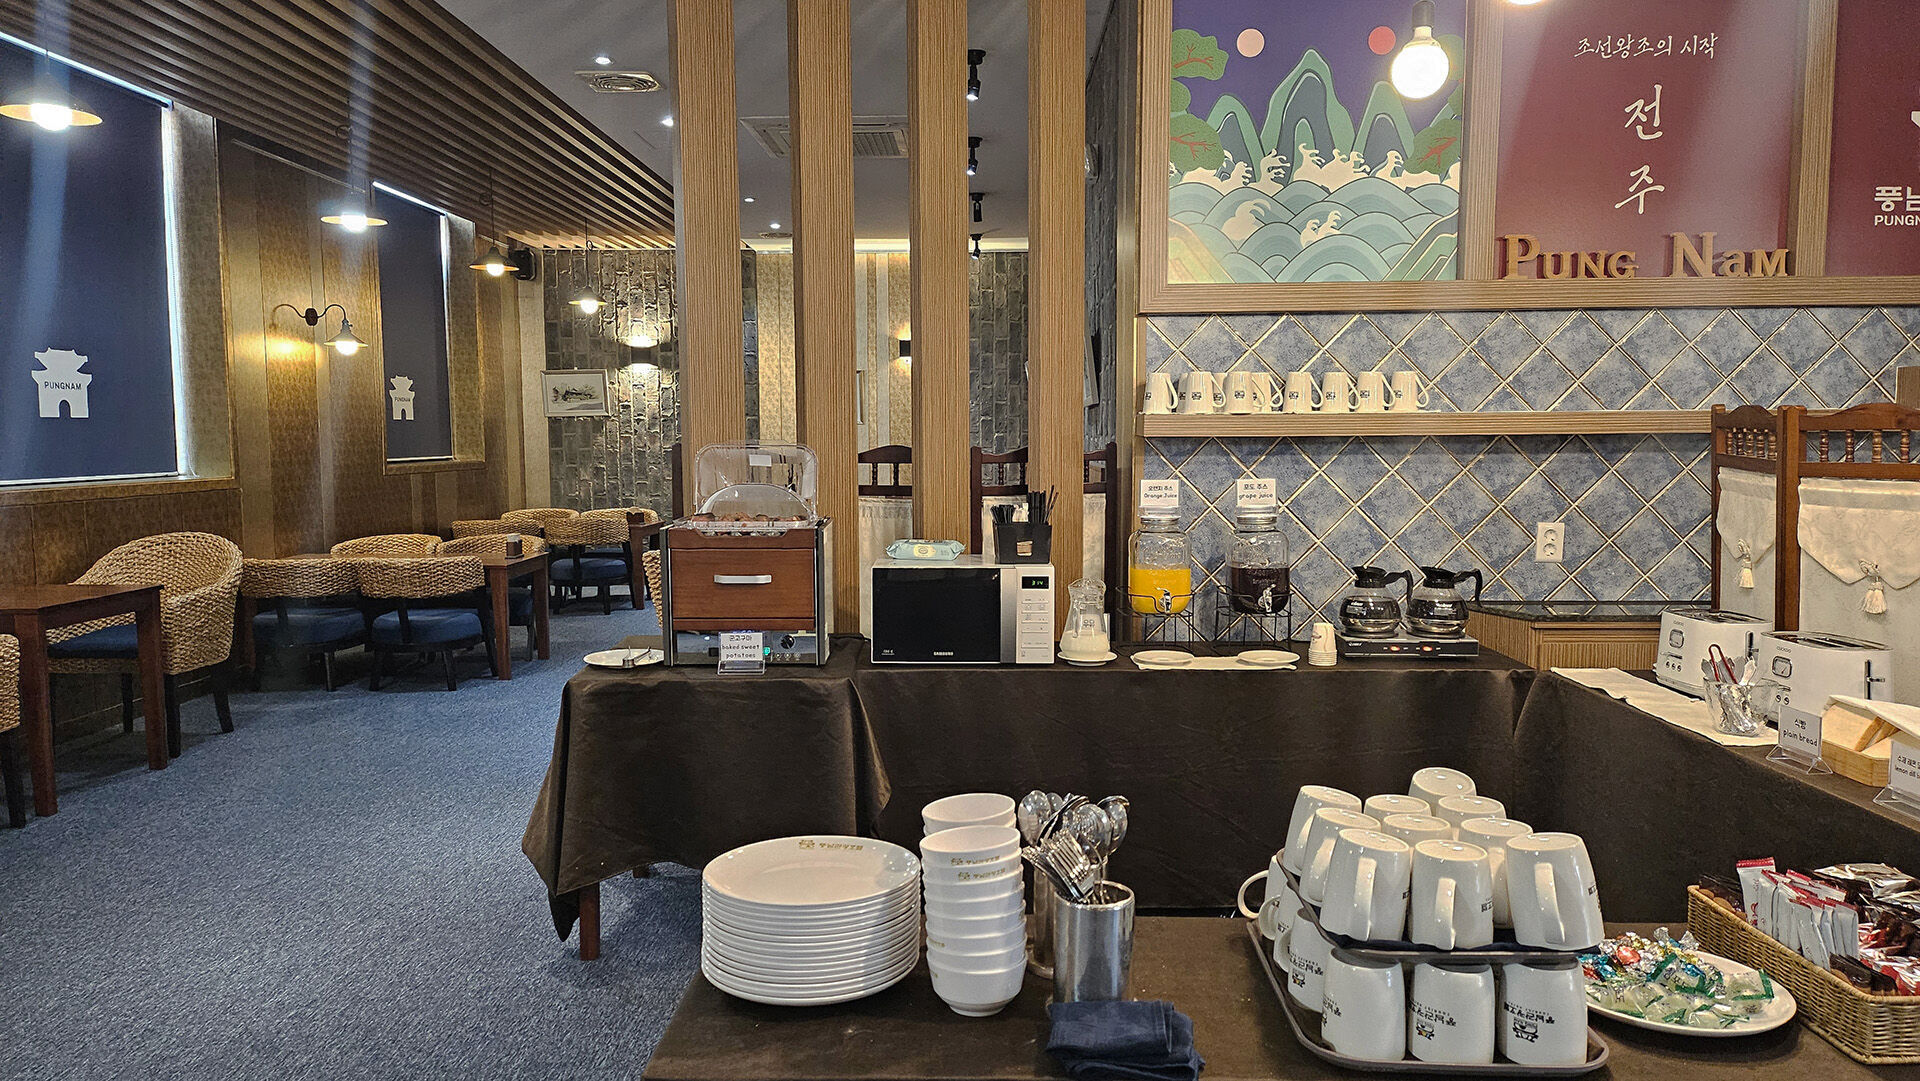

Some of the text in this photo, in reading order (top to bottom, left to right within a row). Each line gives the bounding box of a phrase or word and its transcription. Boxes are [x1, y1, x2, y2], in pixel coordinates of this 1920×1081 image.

[1574, 32, 1719, 59] 조선왕조의 시작
[1614, 84, 1665, 214] 전주
[44, 380, 82, 390] PUNGNAM
[1243, 483, 1255, 491] 포도
[1258, 492, 1273, 500] juice
[1783, 729, 1818, 747] plain bread
[1894, 764, 1908, 775] lemon
